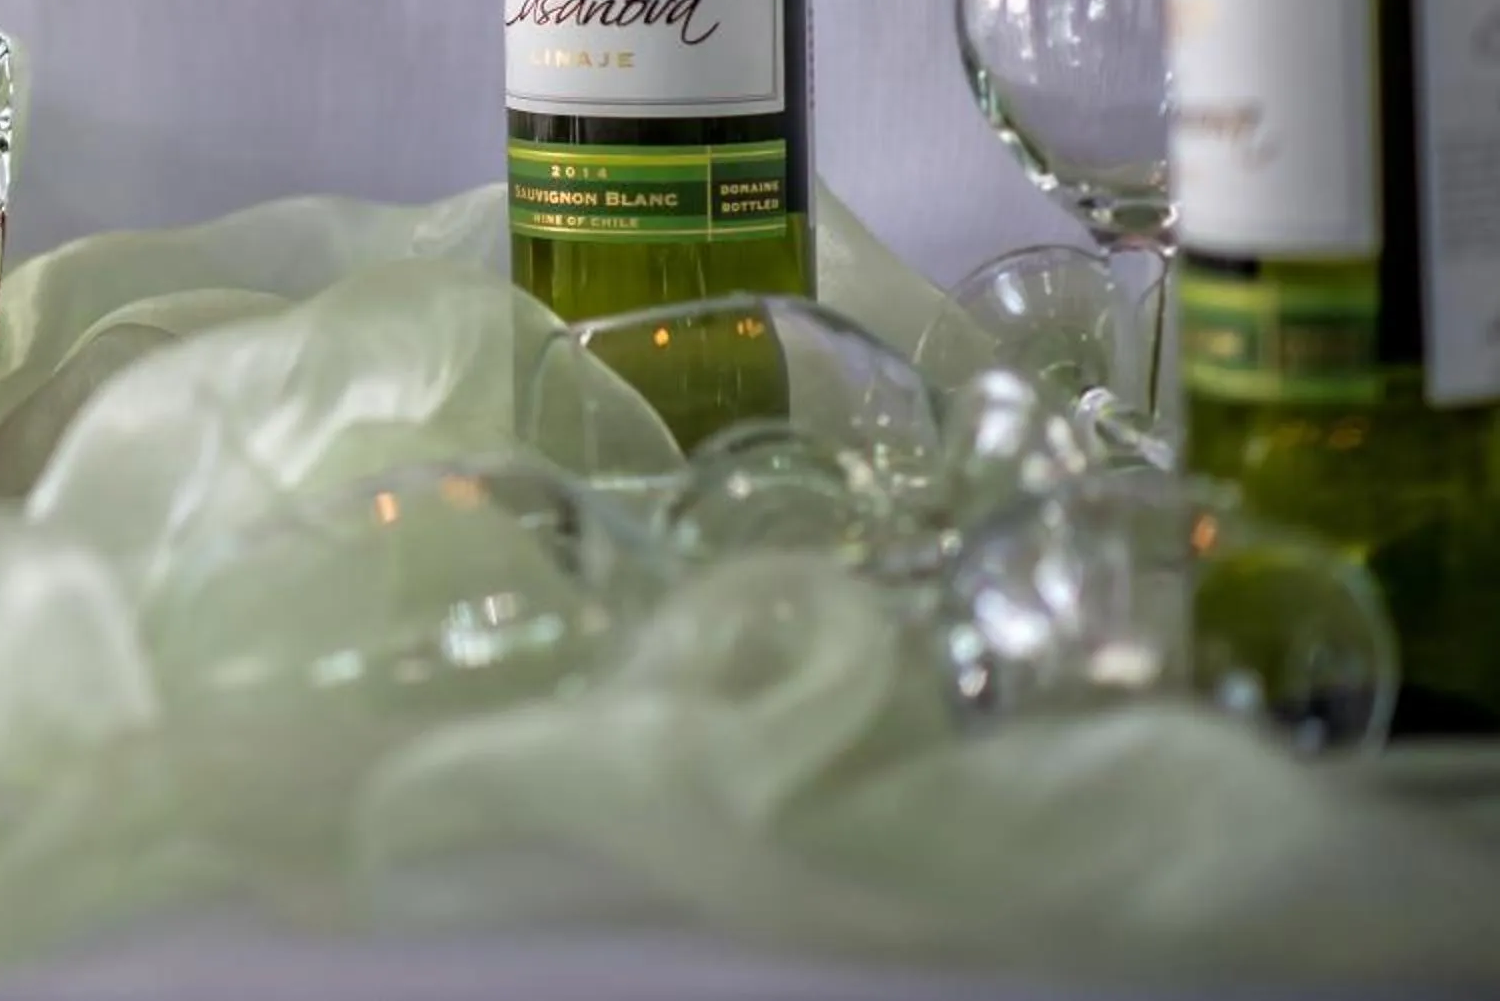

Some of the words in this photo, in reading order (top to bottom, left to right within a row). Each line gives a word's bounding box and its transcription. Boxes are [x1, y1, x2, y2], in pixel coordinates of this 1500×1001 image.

[530, 52, 636, 68] LINAJE
[550, 165, 608, 179] 2014
[514, 184, 598, 205] SAUVIGNON
[606, 191, 679, 206] BLANC
[720, 180, 780, 196] DOMAINE
[566, 215, 586, 227] OF
[590, 217, 640, 229] CHILE
